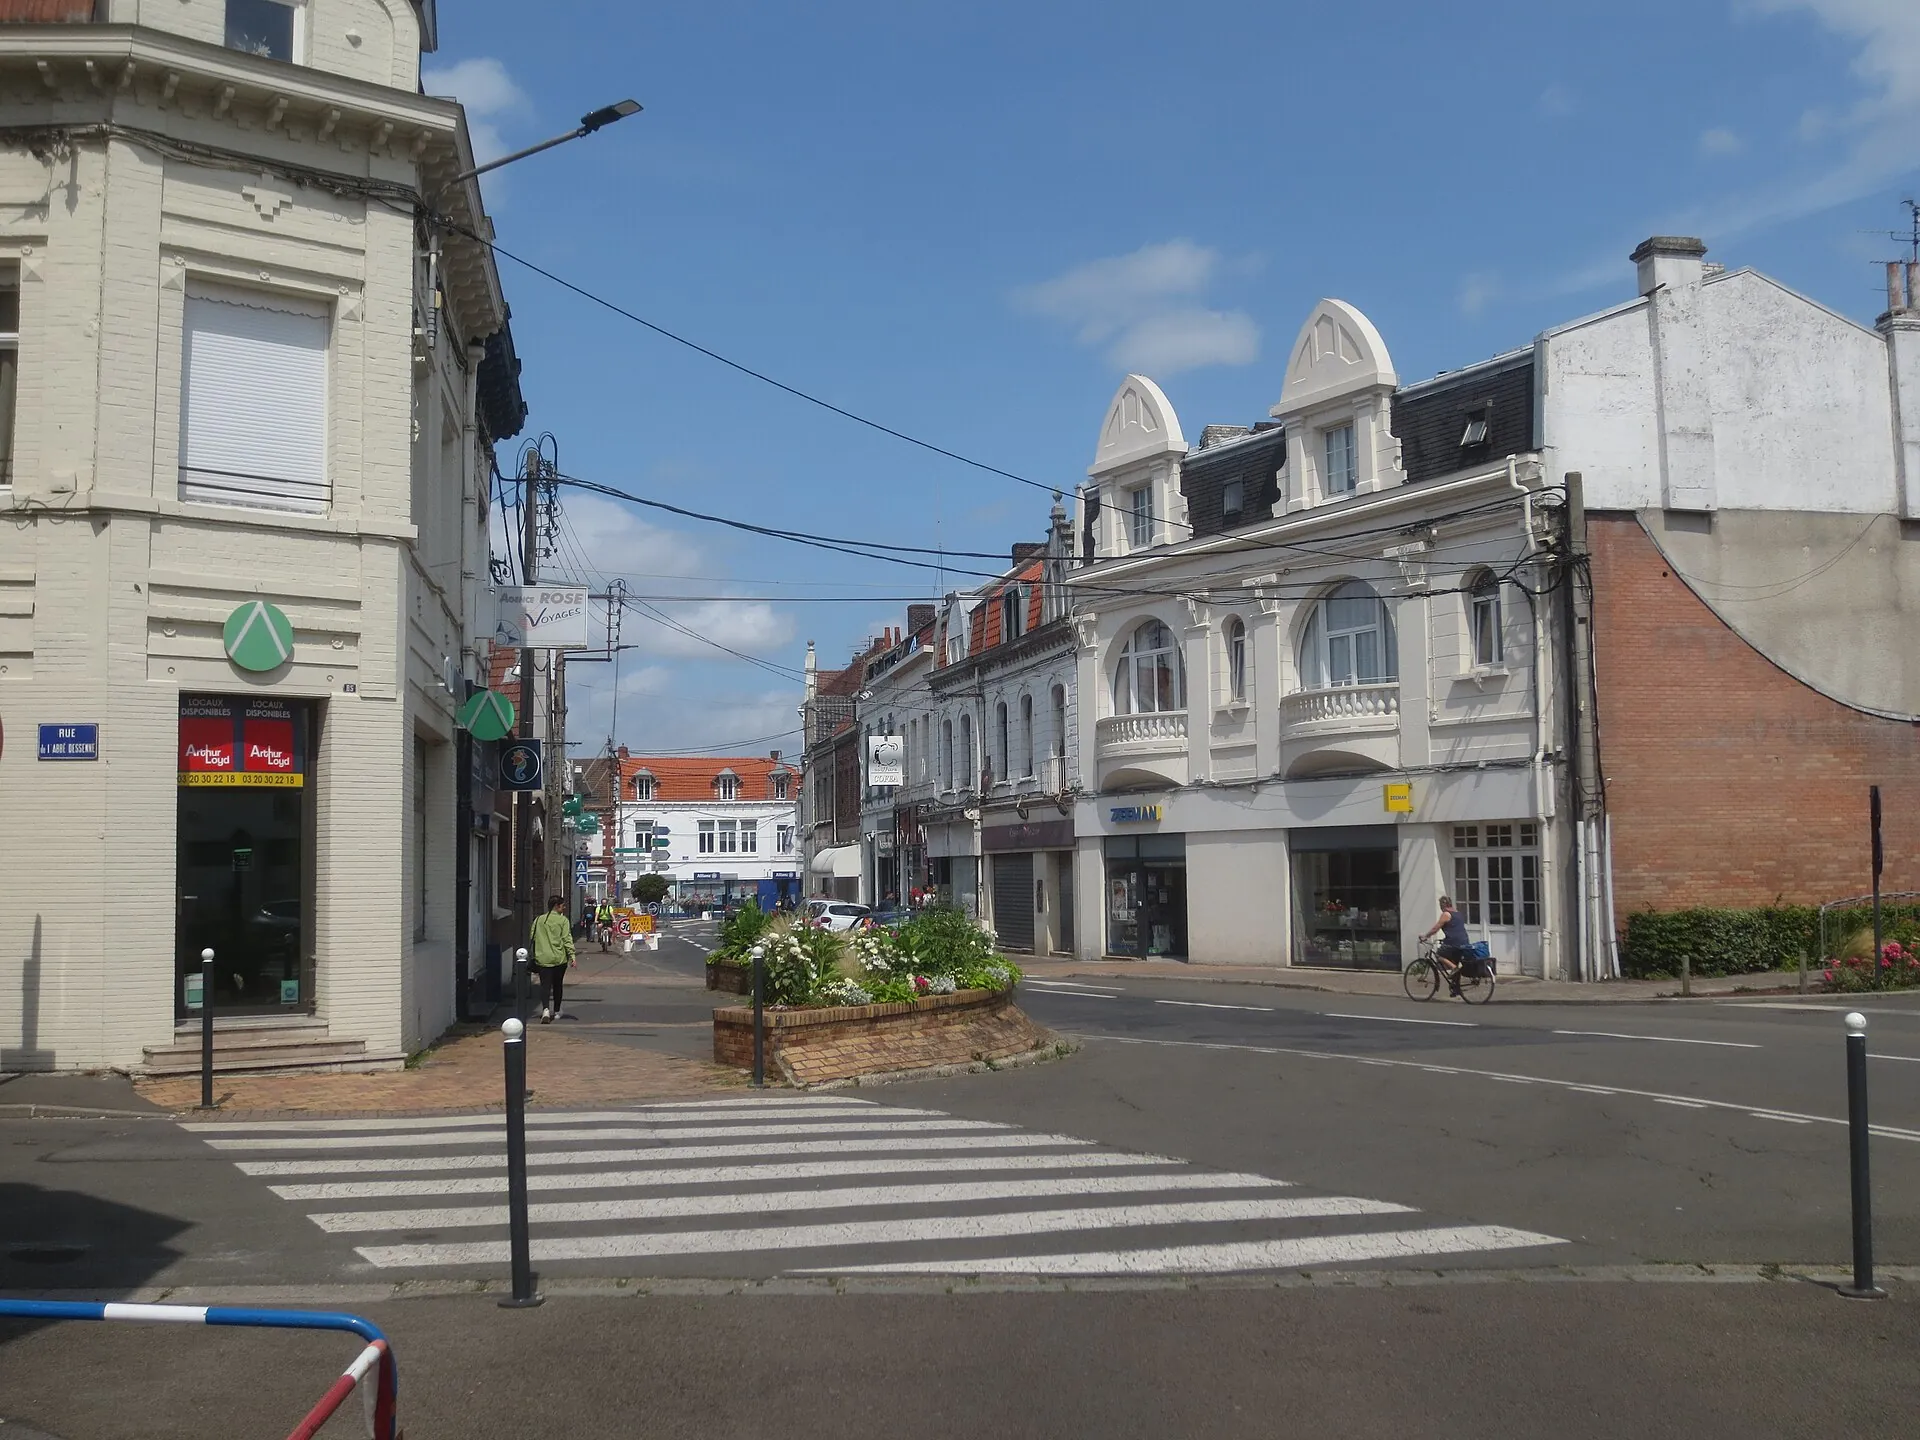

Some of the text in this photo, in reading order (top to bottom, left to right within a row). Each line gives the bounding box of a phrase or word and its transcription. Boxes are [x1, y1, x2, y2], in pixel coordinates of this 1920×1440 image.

[540, 592, 584, 604] ROSE
[525, 607, 581, 627] VOYAGES
[188, 699, 224, 707] LOCAUX
[252, 700, 284, 708] LOCAUX
[181, 707, 231, 716] DISPONIBLES
[245, 709, 291, 719] DISPONIBLES
[58, 728, 76, 738] RUE
[185, 744, 222, 757] Arthur
[250, 744, 283, 758] Arthur
[205, 755, 231, 767] Loyd
[267, 756, 290, 768] Loyd
[177, 775, 236, 784] 03 20 30 22 18
[242, 775, 295, 785] 03 20 30 22 18
[1110, 805, 1161, 822] ZEEMAN
